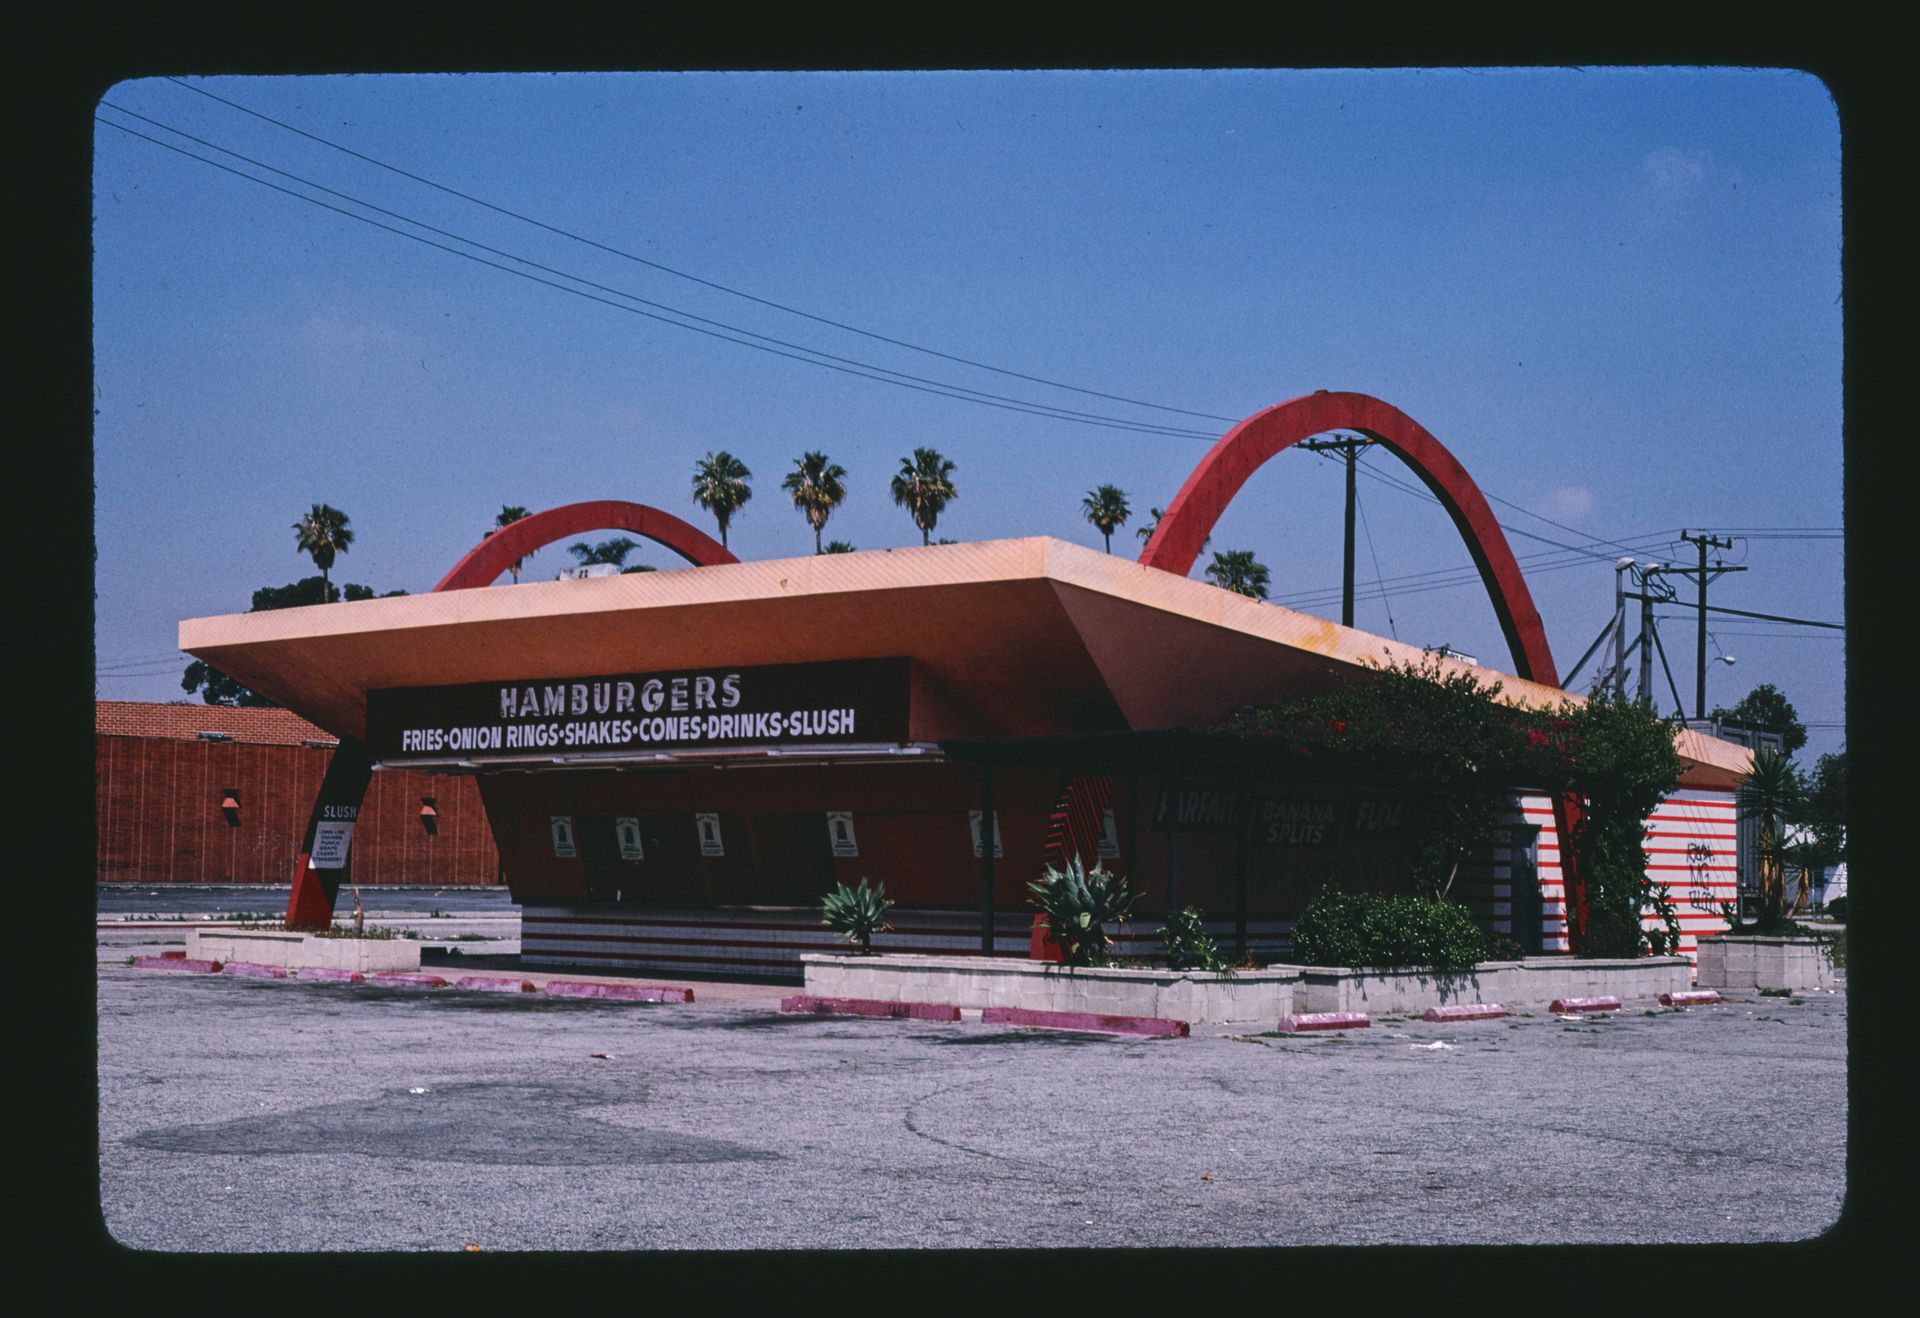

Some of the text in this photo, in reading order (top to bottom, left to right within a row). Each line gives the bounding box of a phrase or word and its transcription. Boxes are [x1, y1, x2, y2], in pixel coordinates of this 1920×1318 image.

[500, 674, 741, 718] HAMBURGERS
[402, 708, 855, 751] FRIES ONION RINGS SHAKES CONES DRINKS SLUSH
[324, 805, 357, 818] SLUSH
[1263, 800, 1334, 823] BANANA
[1266, 822, 1325, 844] SPLITS
